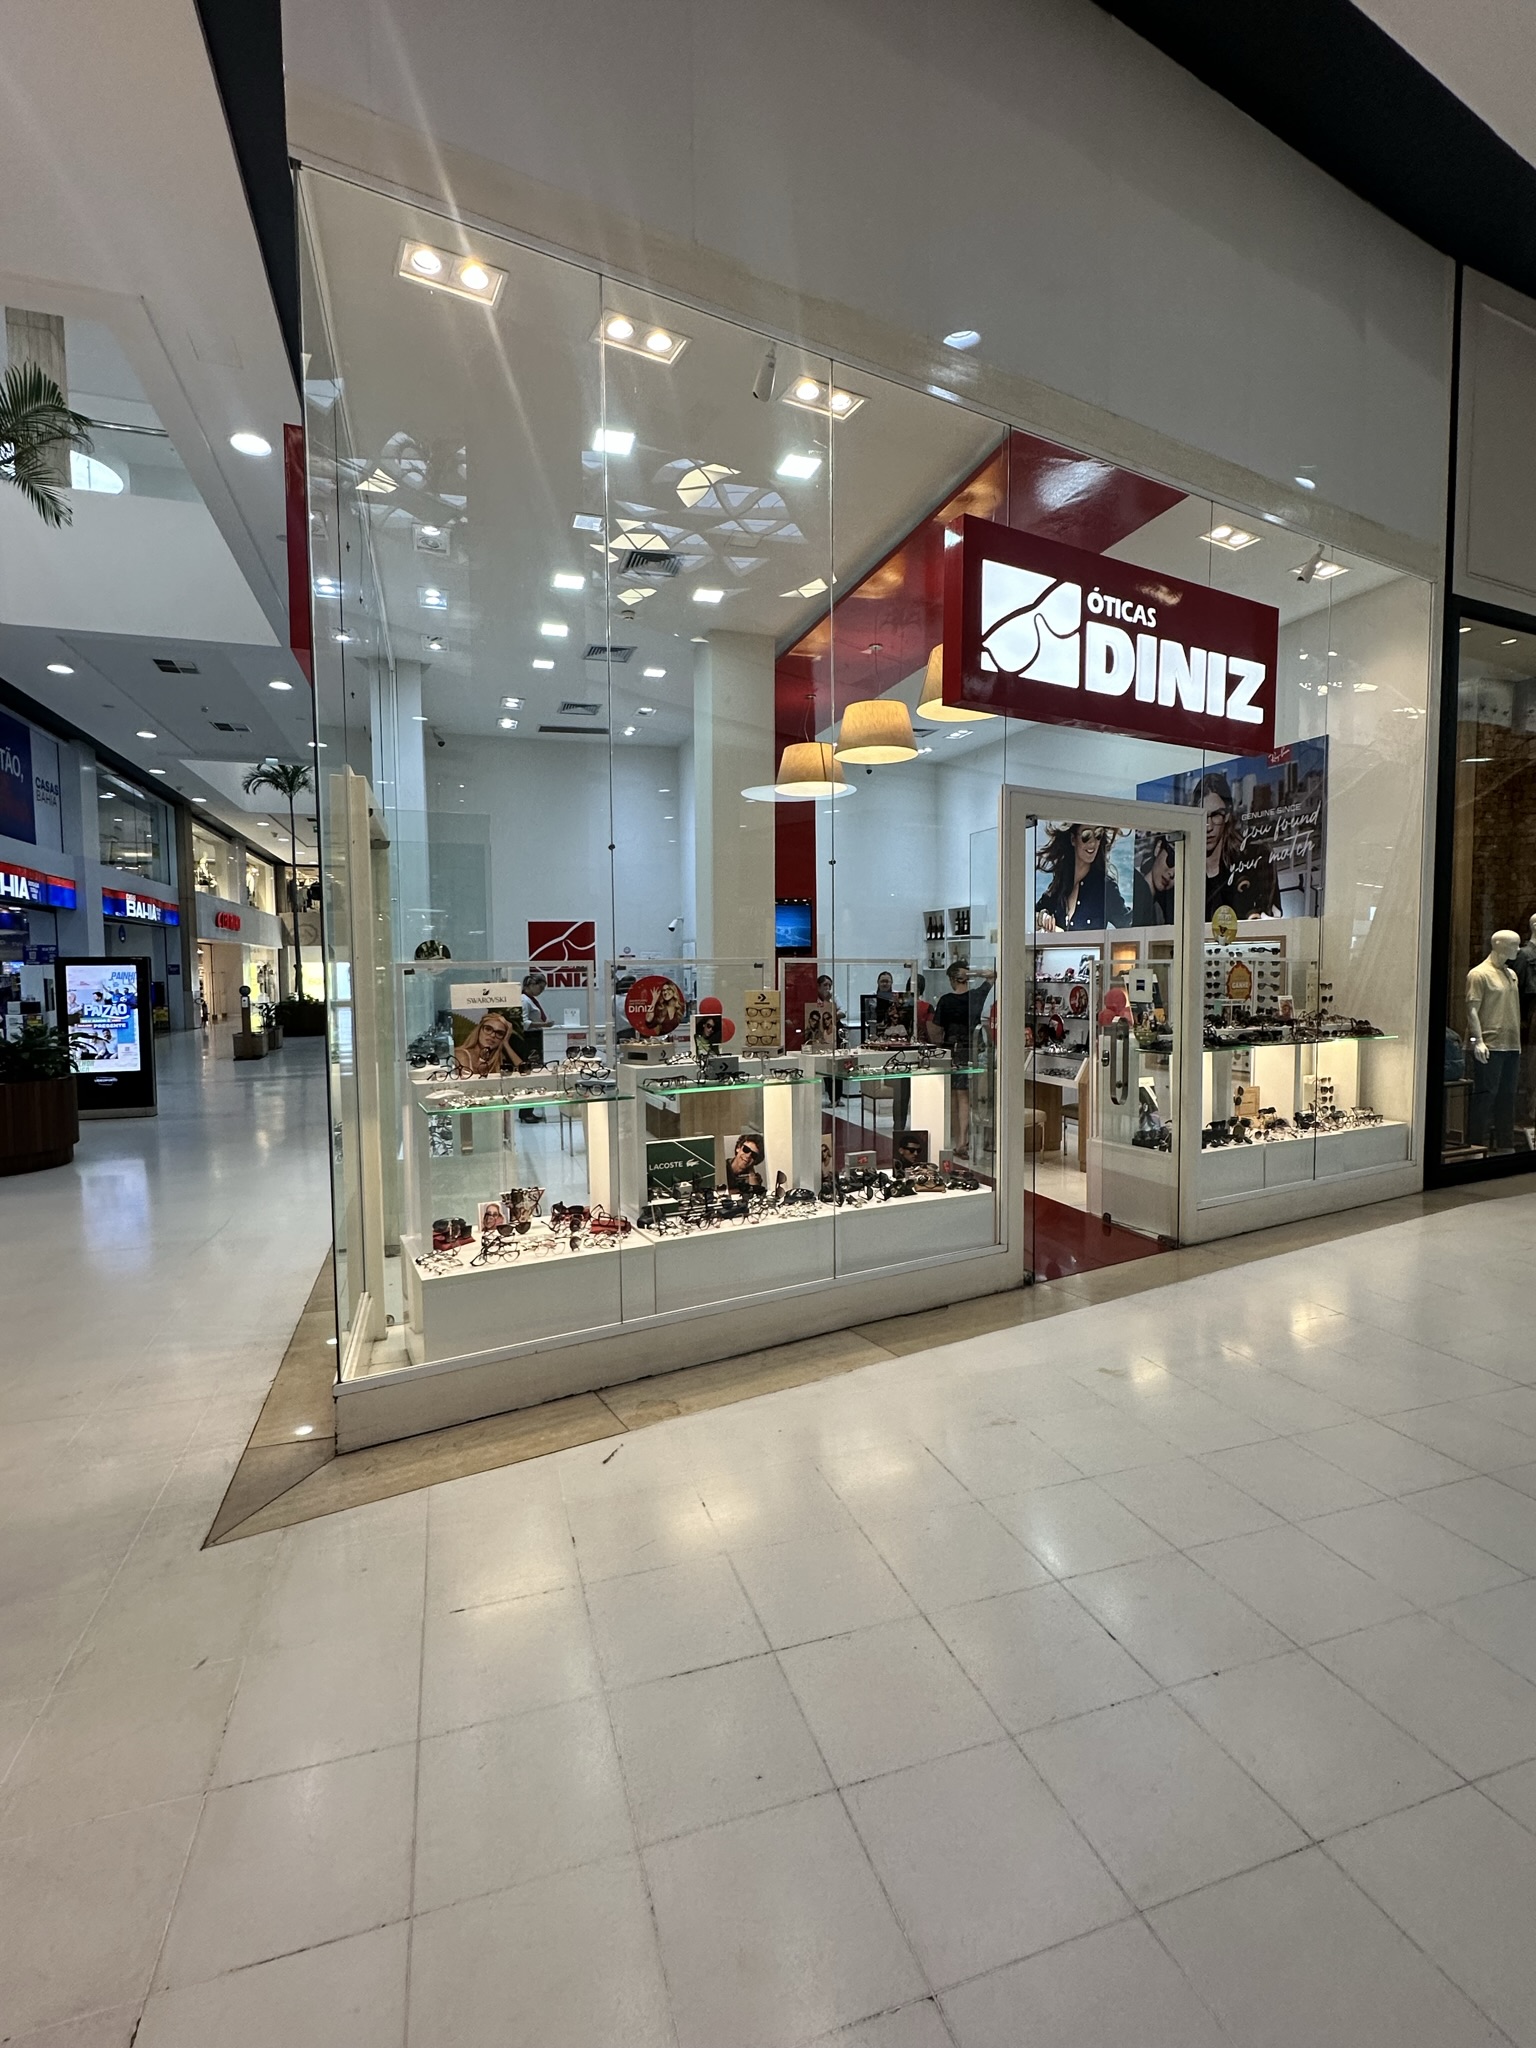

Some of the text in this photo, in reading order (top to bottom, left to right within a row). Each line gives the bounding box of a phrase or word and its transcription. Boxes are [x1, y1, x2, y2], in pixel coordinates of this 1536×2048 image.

[1086, 586, 1157, 628] ÓTICAS
[1085, 620, 1266, 725] DINIZ
[35, 777, 59, 796] CASAS
[1241, 803, 1302, 821] GENUINE SINCE
[1240, 800, 1321, 851] you found
[1227, 830, 1315, 886] your match
[126, 899, 158, 921] BAHIA
[531, 973, 596, 987] INIZ
[466, 996, 507, 1004] SWAROVSKI
[628, 1005, 654, 1013] DINIZ
[84, 1002, 129, 1019] PAIZÃO
[648, 1160, 683, 1170] LACOSTE
